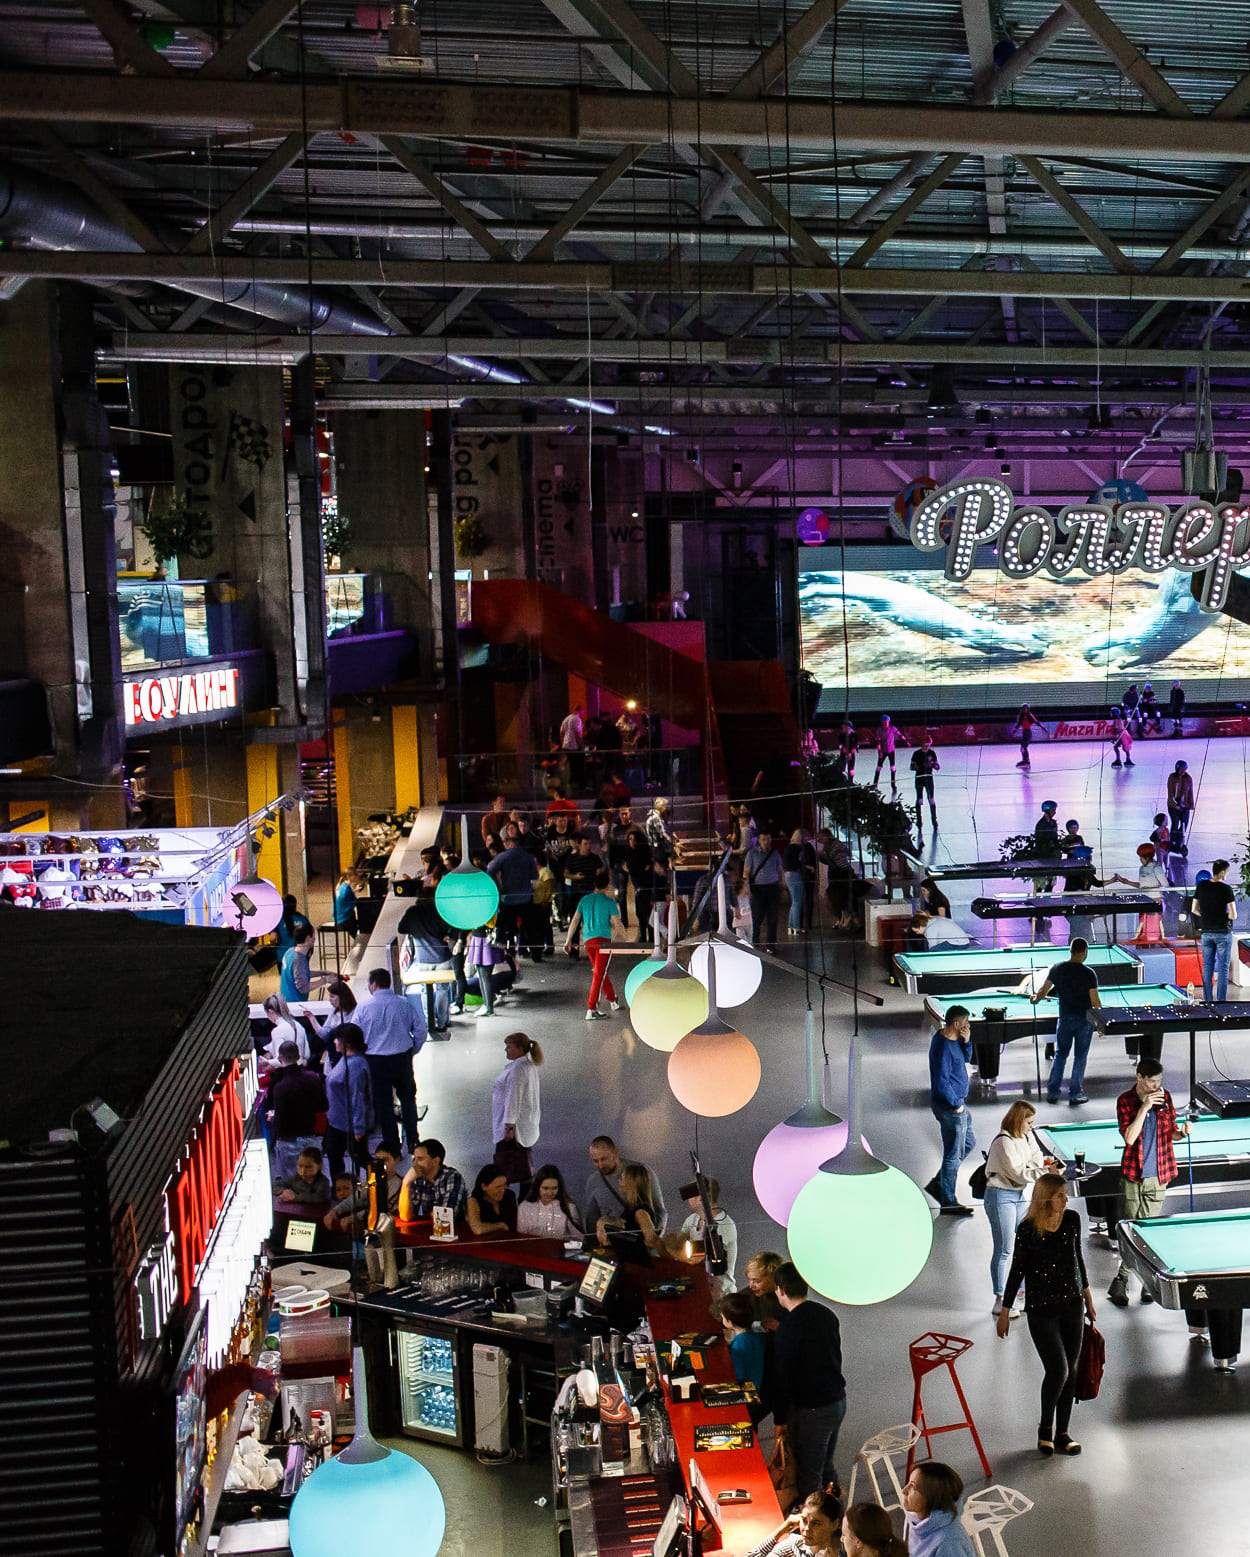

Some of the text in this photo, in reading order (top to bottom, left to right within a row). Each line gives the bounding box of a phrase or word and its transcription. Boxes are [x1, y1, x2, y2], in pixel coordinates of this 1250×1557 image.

[536, 480, 555, 568] cinema
[609, 526, 645, 543] WC
[123, 668, 239, 725] БОУЛИНГ
[148, 1232, 179, 1340] THE
[176, 1056, 244, 1307] FAMOUS
